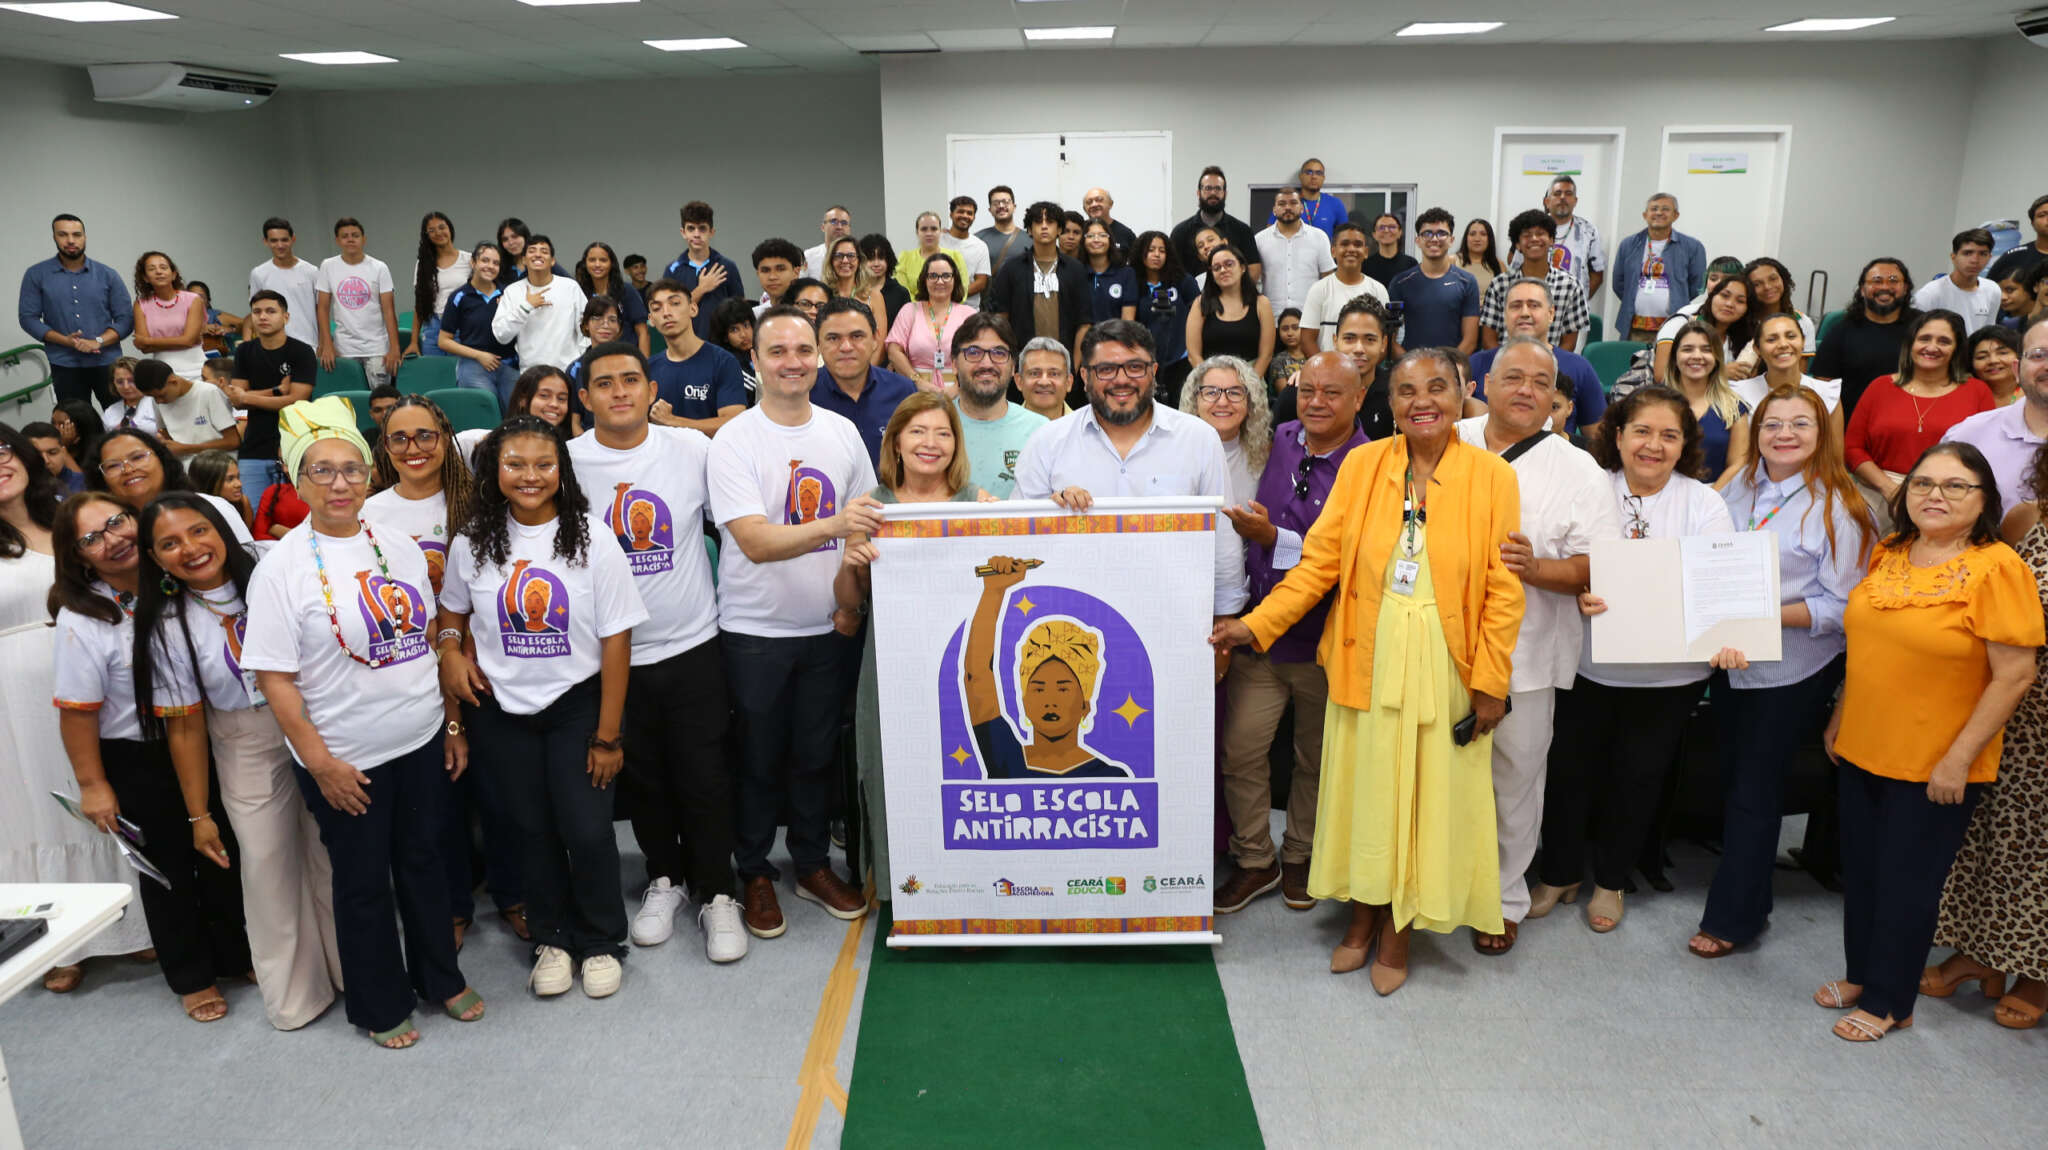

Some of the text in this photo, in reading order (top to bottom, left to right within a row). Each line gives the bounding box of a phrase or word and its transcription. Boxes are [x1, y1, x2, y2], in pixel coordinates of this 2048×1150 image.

[635, 553, 670, 563] ESCOLA
[507, 635, 565, 645] SELO ESCOLA
[959, 788, 1140, 813] SELO ESCOLA
[1067, 876, 1104, 887] CEARÁ
[1160, 874, 1205, 886] CEARÁ
[1067, 887, 1104, 895] EDUCA
